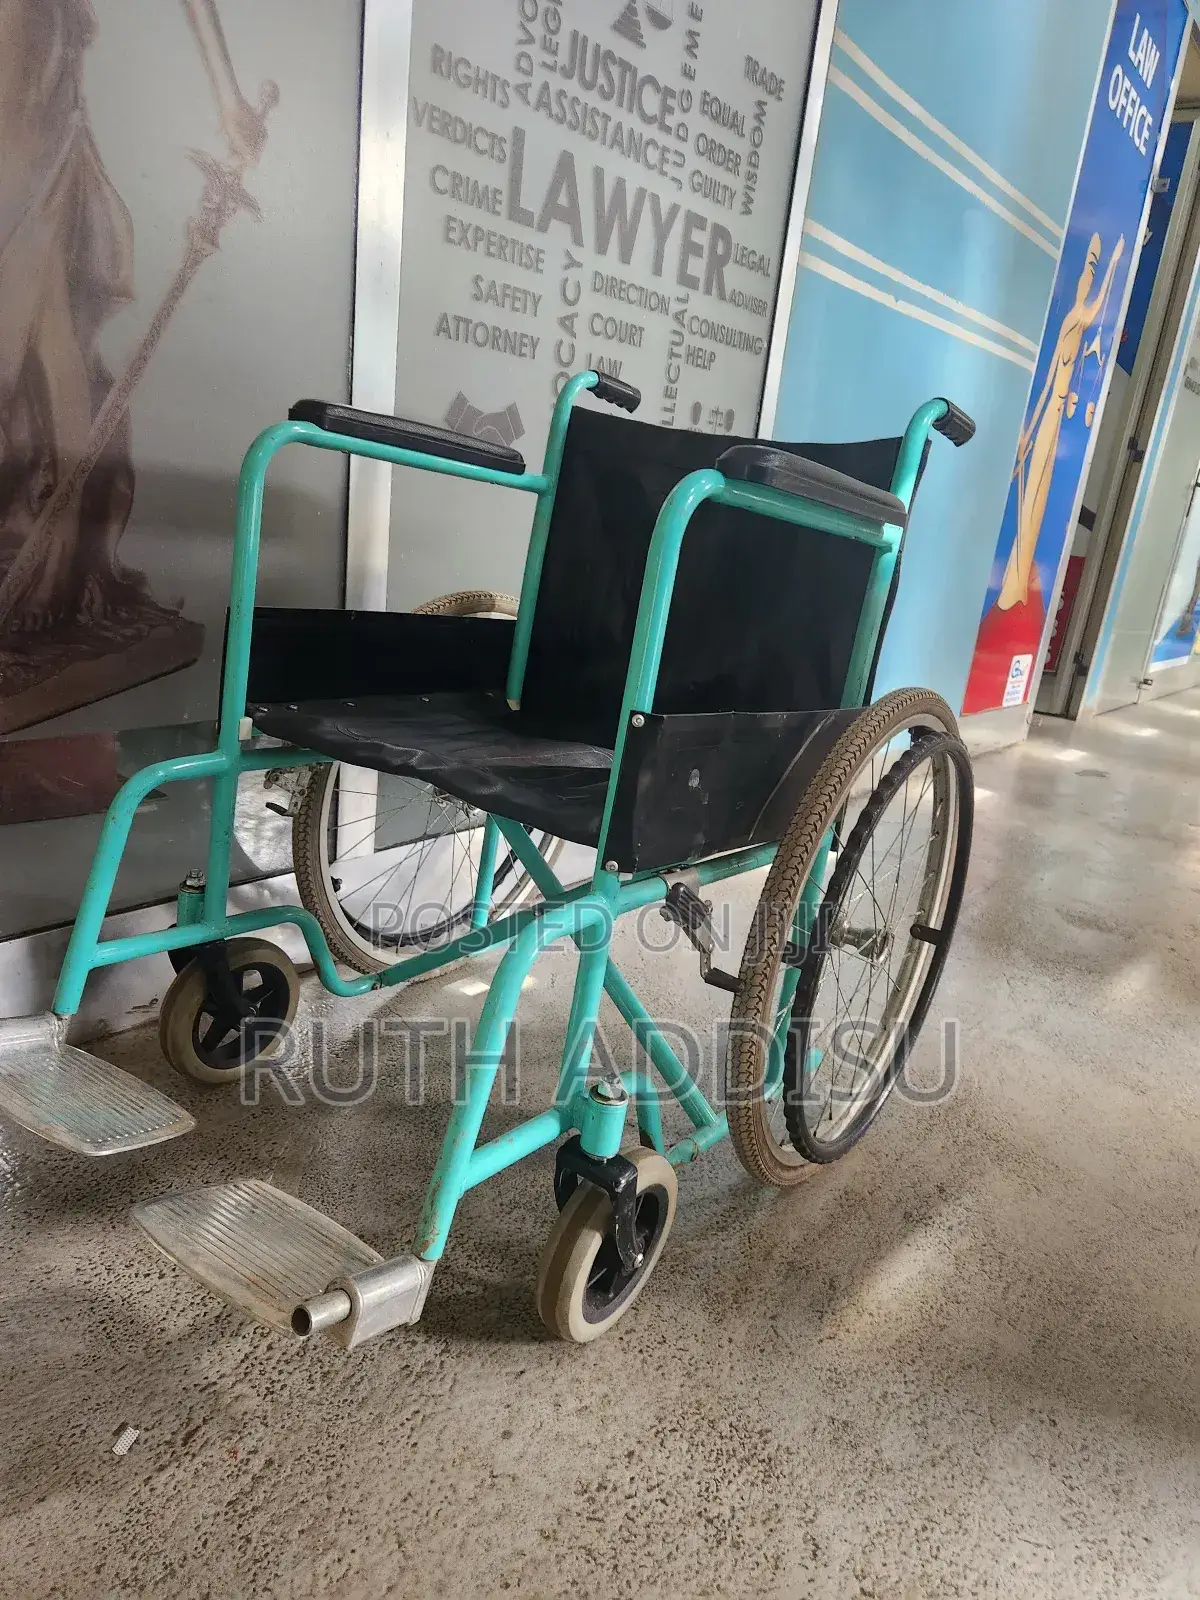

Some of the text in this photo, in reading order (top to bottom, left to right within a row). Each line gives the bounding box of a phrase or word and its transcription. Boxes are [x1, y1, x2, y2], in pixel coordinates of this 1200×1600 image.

[1128, 12, 1160, 90] LAW
[430, 43, 511, 109] RIGHTS
[557, 28, 677, 136] JUSTICE
[743, 54, 785, 102] TRADE
[411, 97, 507, 164] VERDICTS
[534, 80, 671, 178] ASSISTANCE
[700, 90, 746, 138] EQUAL
[1108, 63, 1152, 157] OFFICE
[694, 132, 743, 178] ORDER
[739, 99, 768, 215] WISDOM
[429, 164, 504, 216] CRIME
[508, 126, 734, 302] LAWYER
[688, 169, 738, 211] GUILTY
[442, 214, 547, 274] EXPERTISE
[732, 243, 772, 279] LEGAL
[471, 274, 543, 318] SAFETY
[591, 270, 672, 317] DIRECTION
[727, 288, 769, 318] ADVISER
[434, 312, 541, 361] ATTORNEY
[589, 312, 646, 349] COURT
[686, 315, 765, 356] CONSULTING
[684, 344, 717, 371] HELP
